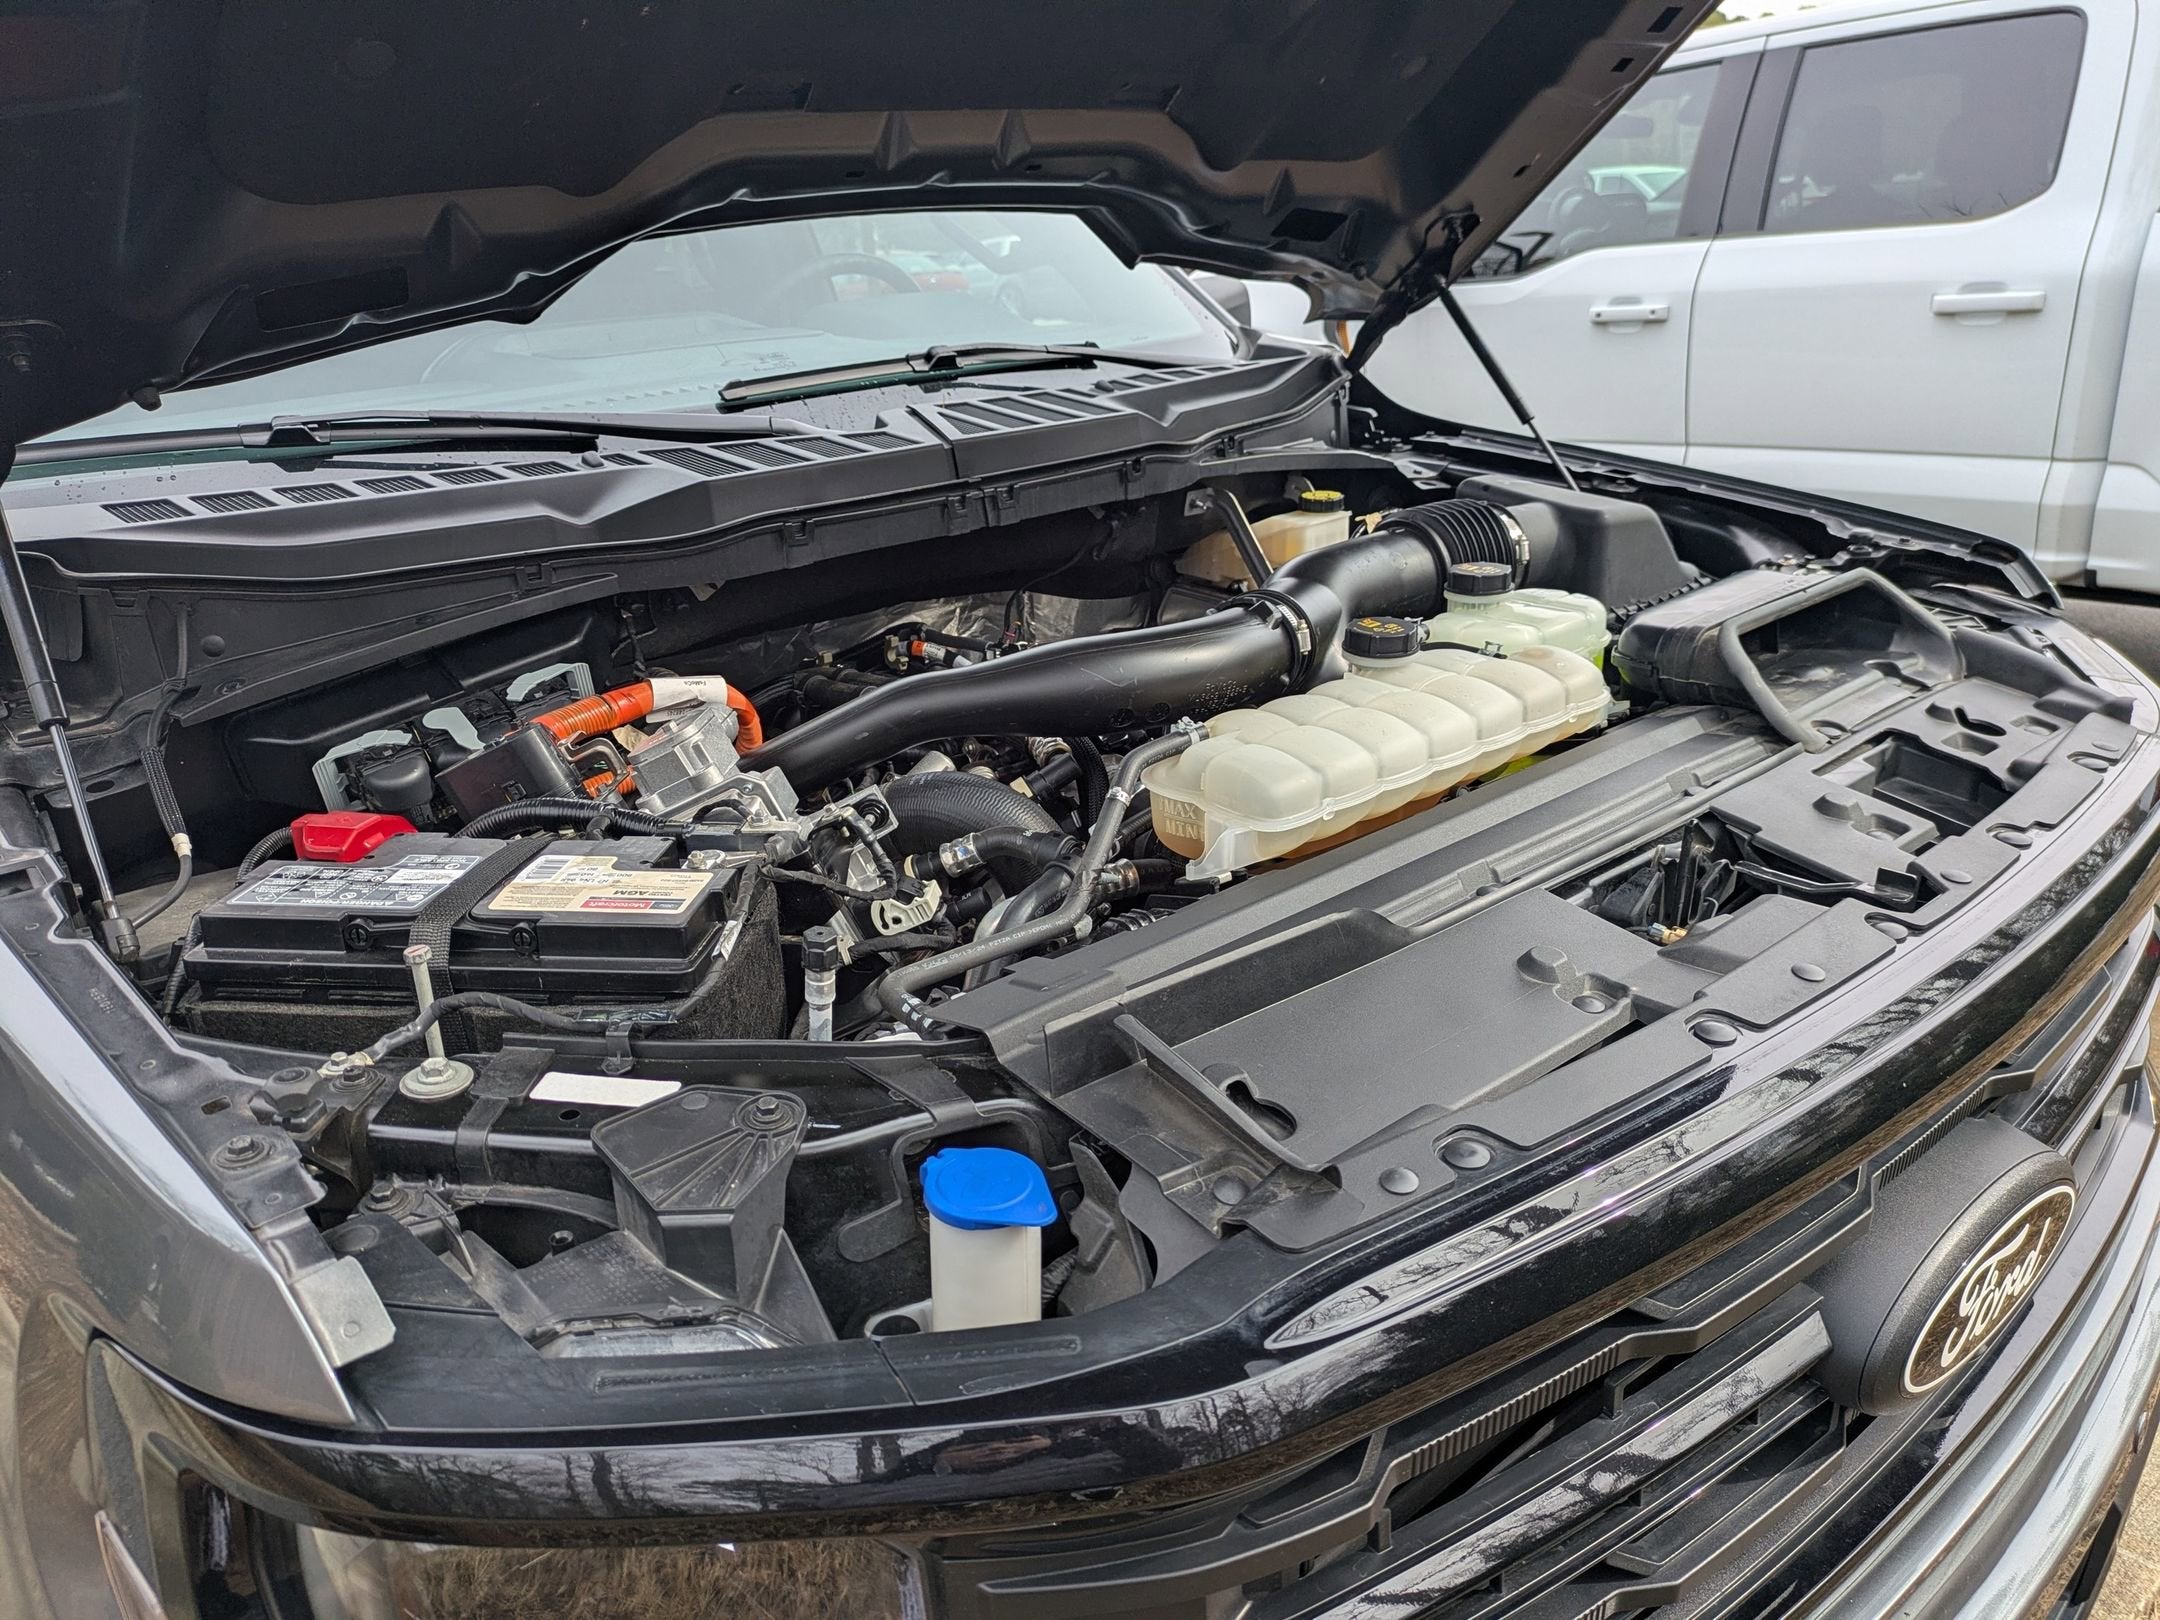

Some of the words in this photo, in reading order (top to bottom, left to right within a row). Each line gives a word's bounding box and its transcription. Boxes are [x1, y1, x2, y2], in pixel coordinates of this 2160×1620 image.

[1165, 799, 1196, 819] MAX
[1166, 819, 1198, 839] MIN
[1940, 1217, 2052, 1368] Ford
